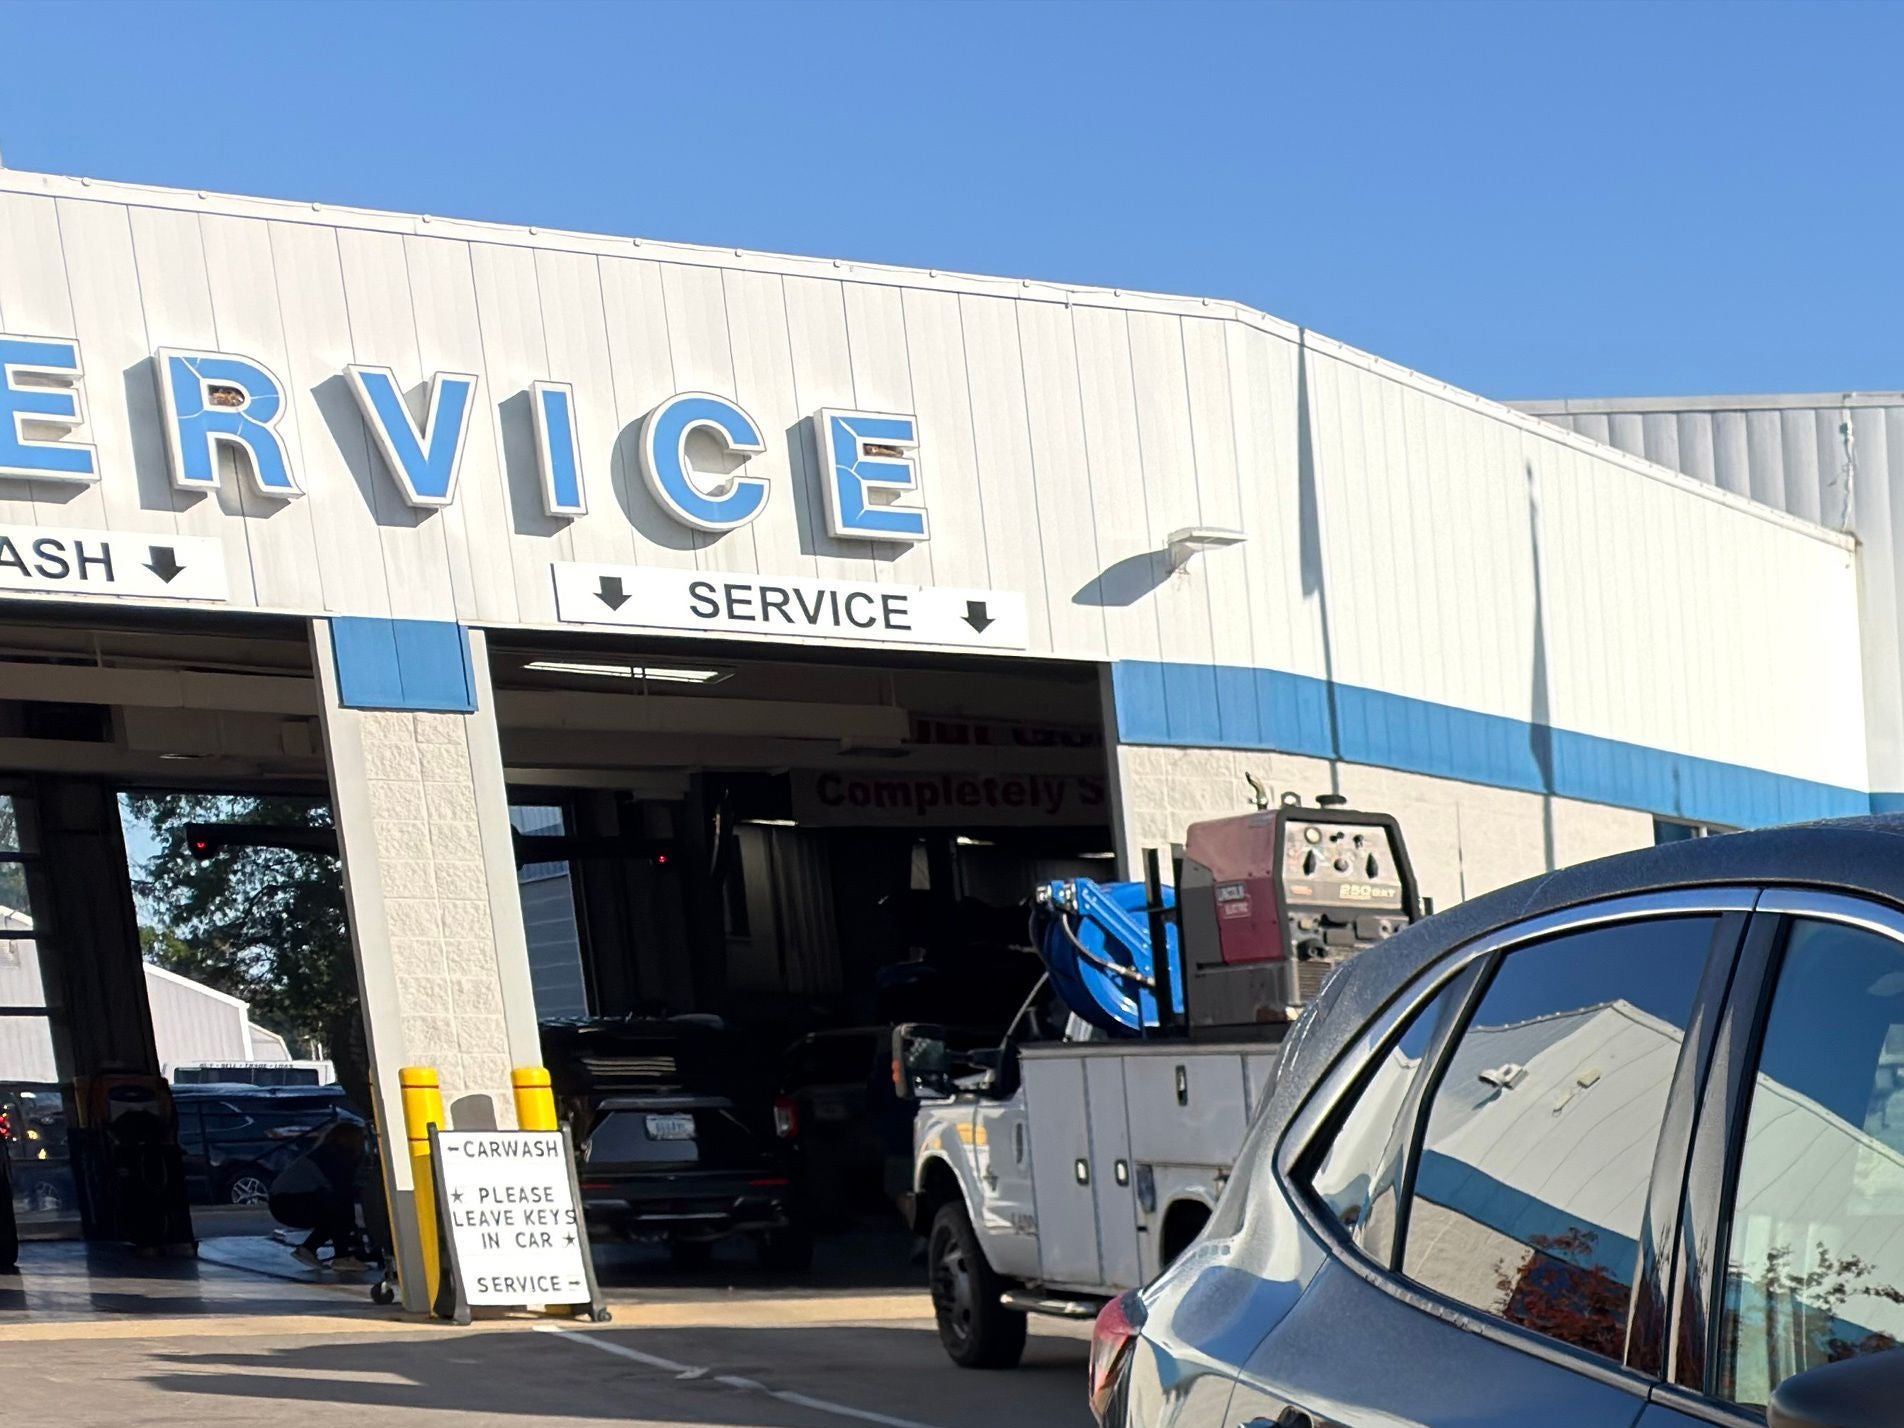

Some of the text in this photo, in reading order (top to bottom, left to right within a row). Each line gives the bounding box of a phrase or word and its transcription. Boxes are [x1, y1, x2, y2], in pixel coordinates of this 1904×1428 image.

[688, 580, 912, 633] SERVICE
[817, 773, 1064, 815] Completely
[463, 1140, 559, 1158] CARWASH
[479, 1186, 555, 1204] PLEASE
[453, 1209, 578, 1227] LEAVE KEYS
[482, 1231, 553, 1249] IN CAR
[477, 1275, 562, 1293] SERVICE
